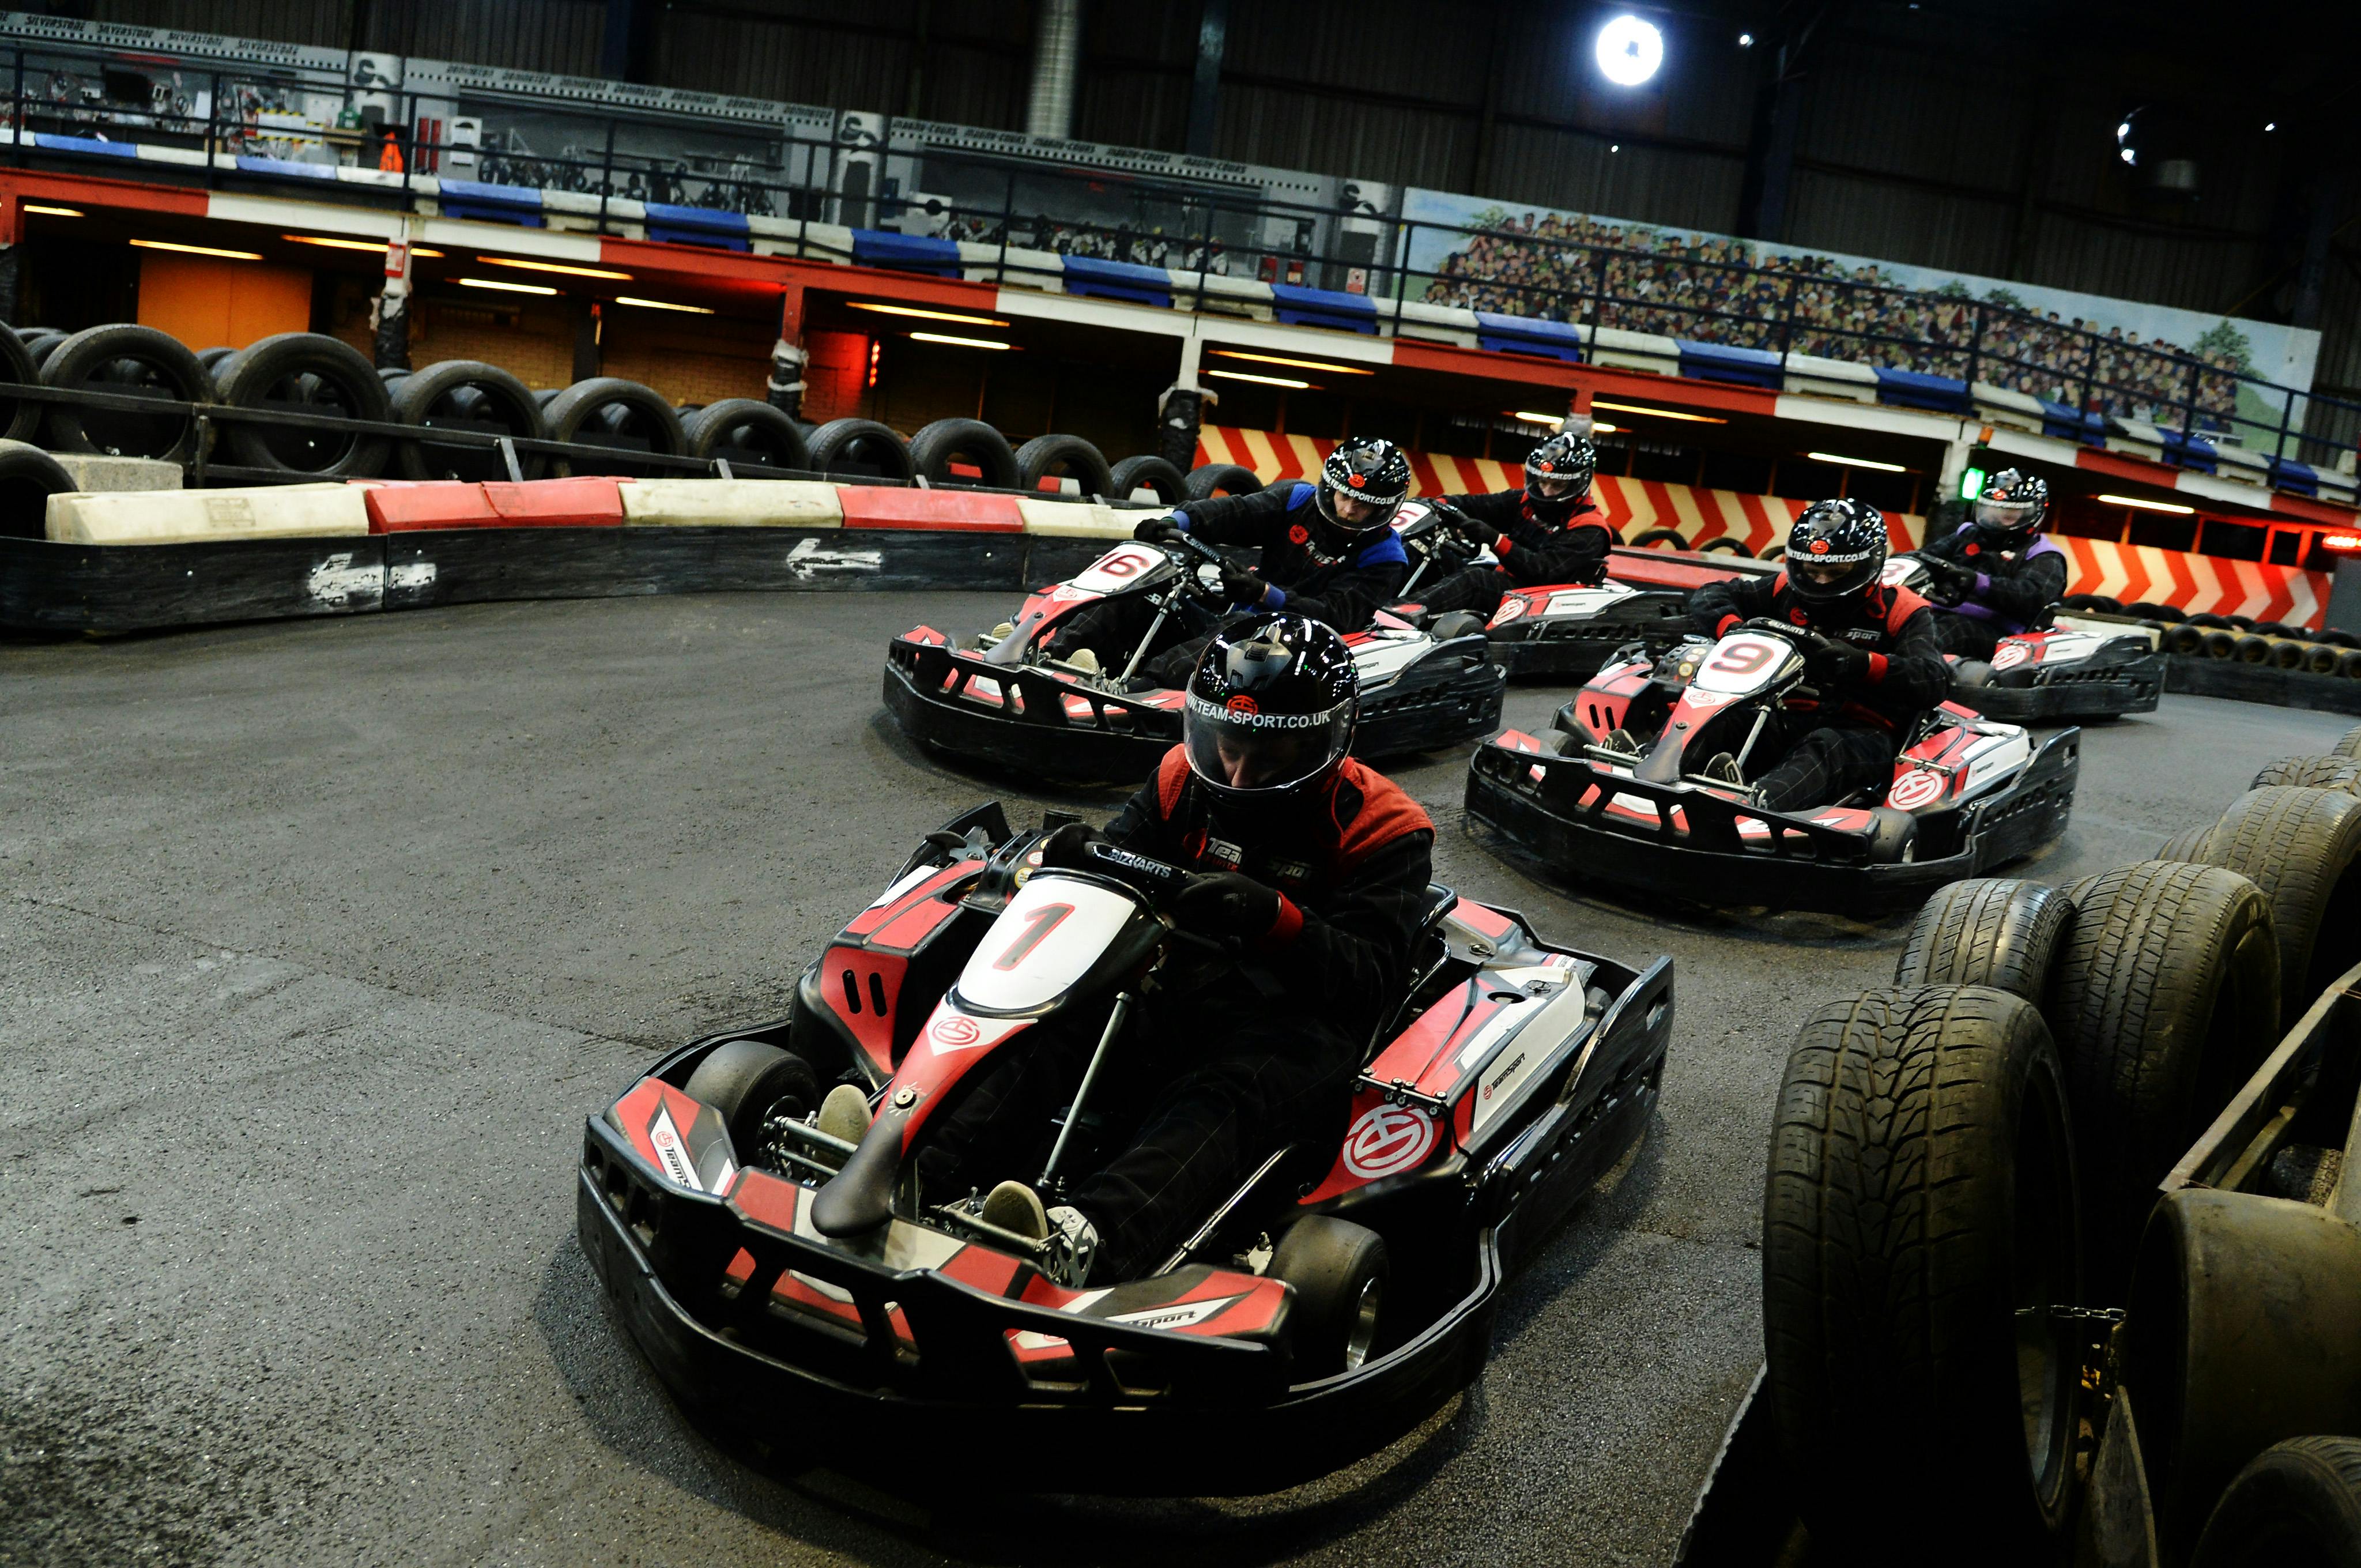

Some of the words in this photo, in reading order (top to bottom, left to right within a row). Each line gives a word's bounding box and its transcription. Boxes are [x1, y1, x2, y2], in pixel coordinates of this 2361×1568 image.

[1710, 643, 1774, 674] 9
[1109, 848, 1171, 878] BIZKARTS
[992, 902, 1076, 971] 1
